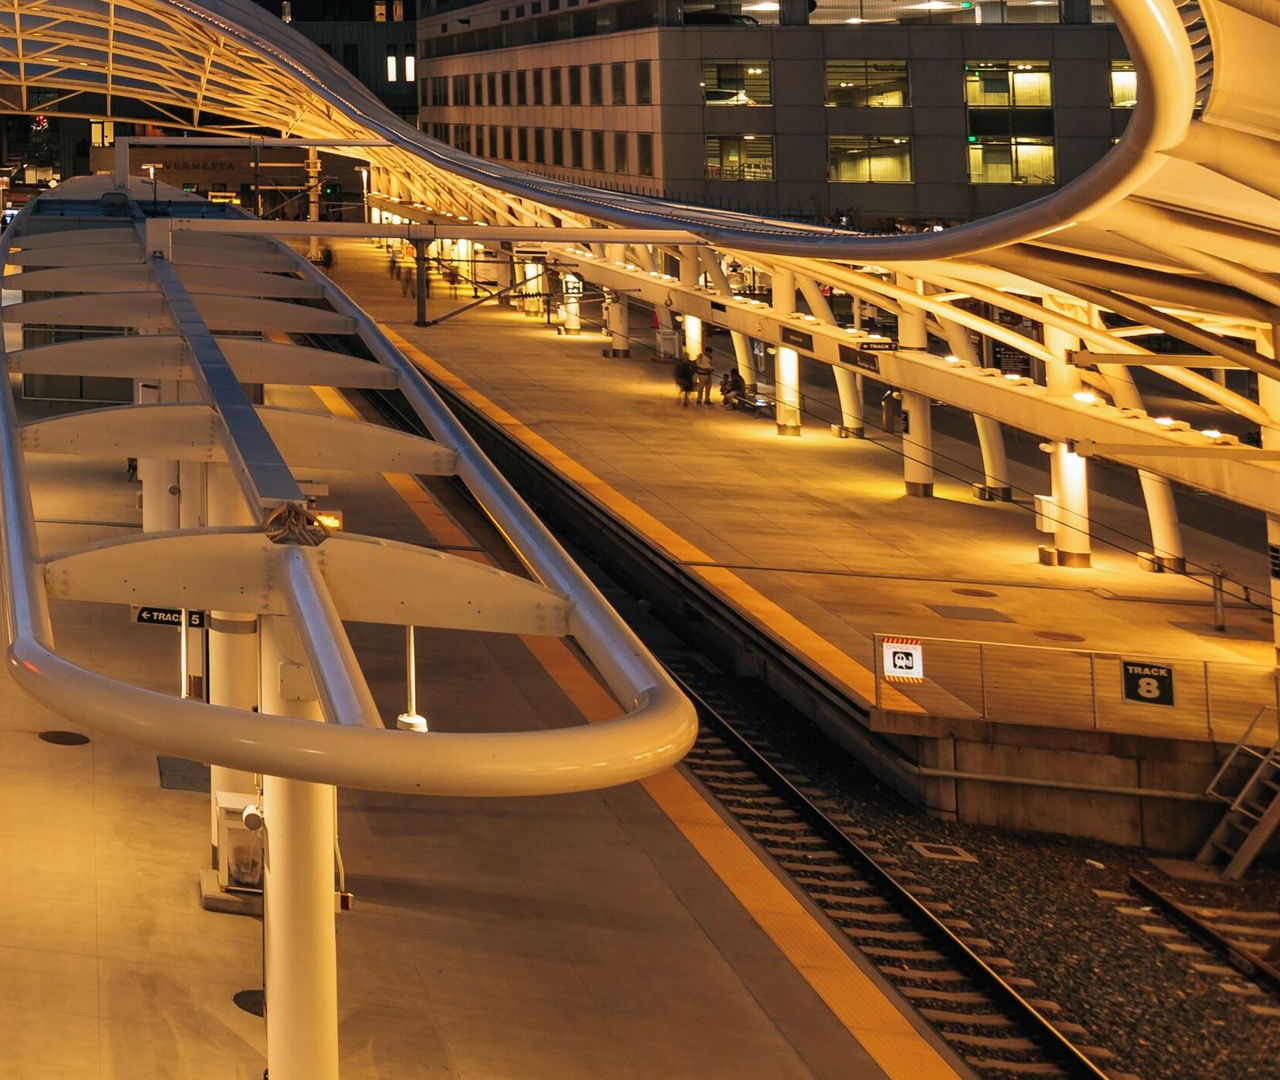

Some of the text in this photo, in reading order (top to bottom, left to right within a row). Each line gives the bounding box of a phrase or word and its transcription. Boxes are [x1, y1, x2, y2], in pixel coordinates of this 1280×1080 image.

[869, 342, 890, 350] TRACK
[152, 611, 200, 625] TRAC 5
[1126, 666, 1169, 677] TRACK
[1137, 677, 1160, 699] 8
